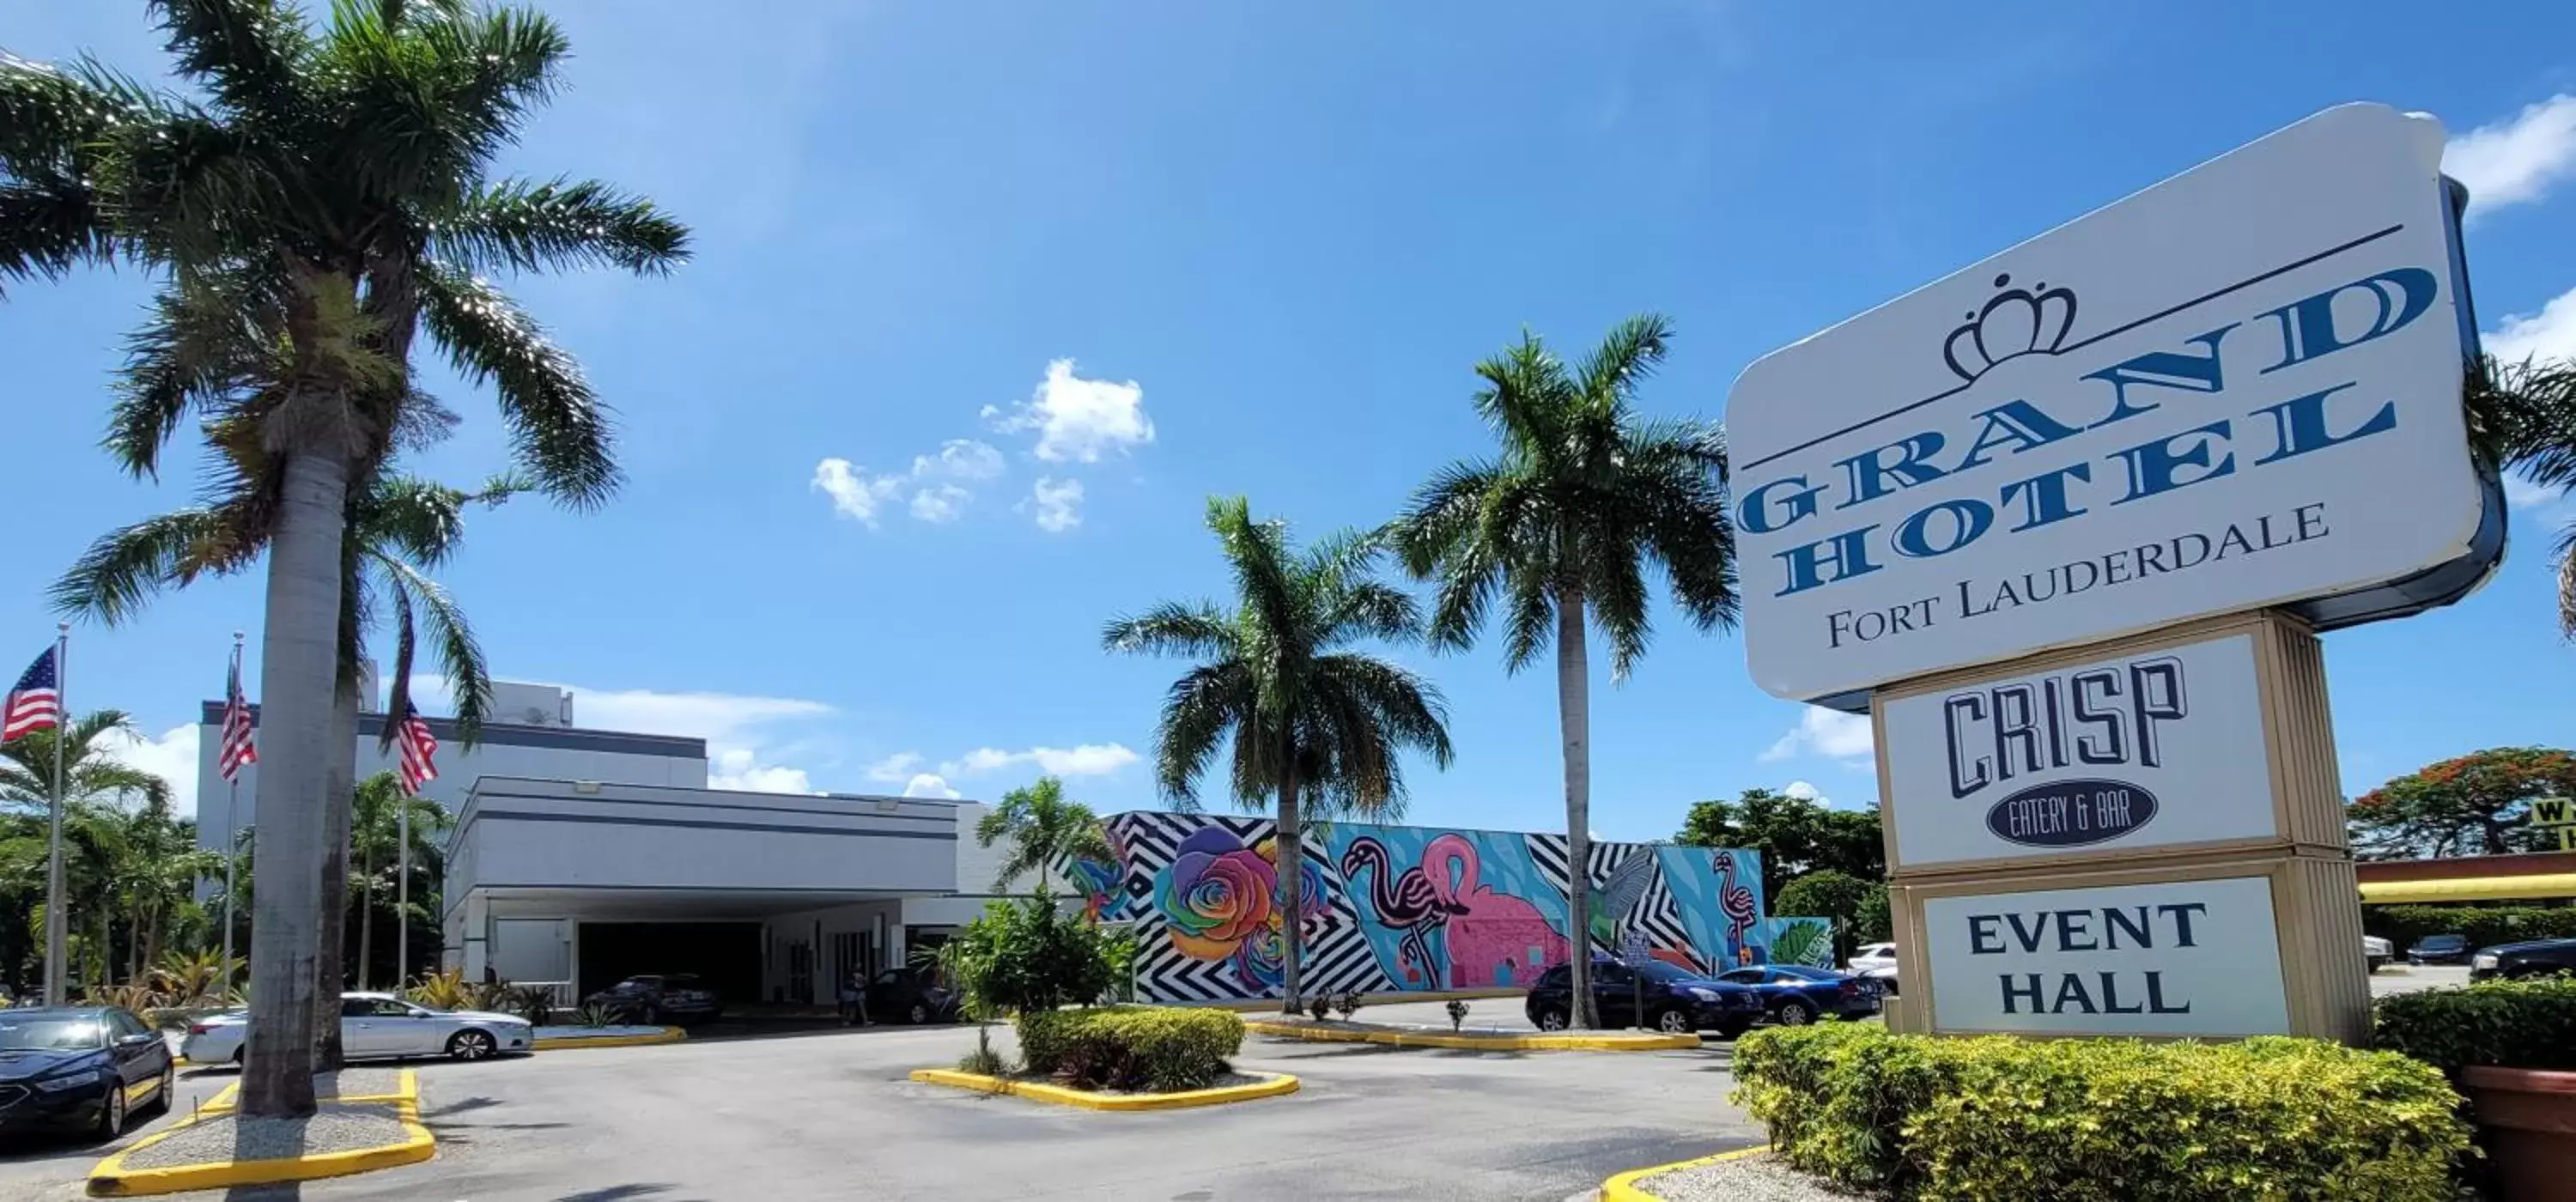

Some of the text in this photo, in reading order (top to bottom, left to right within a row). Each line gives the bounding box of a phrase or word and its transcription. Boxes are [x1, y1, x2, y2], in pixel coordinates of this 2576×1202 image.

[1736, 268, 2438, 535] GRAND
[1773, 380, 2397, 598] HOTEL
[1944, 655, 2188, 799] CRISP
[2008, 789, 2133, 837] EATERY & BAR
[1967, 903, 2208, 956] EVENT
[1999, 971, 2191, 1015] HALL
